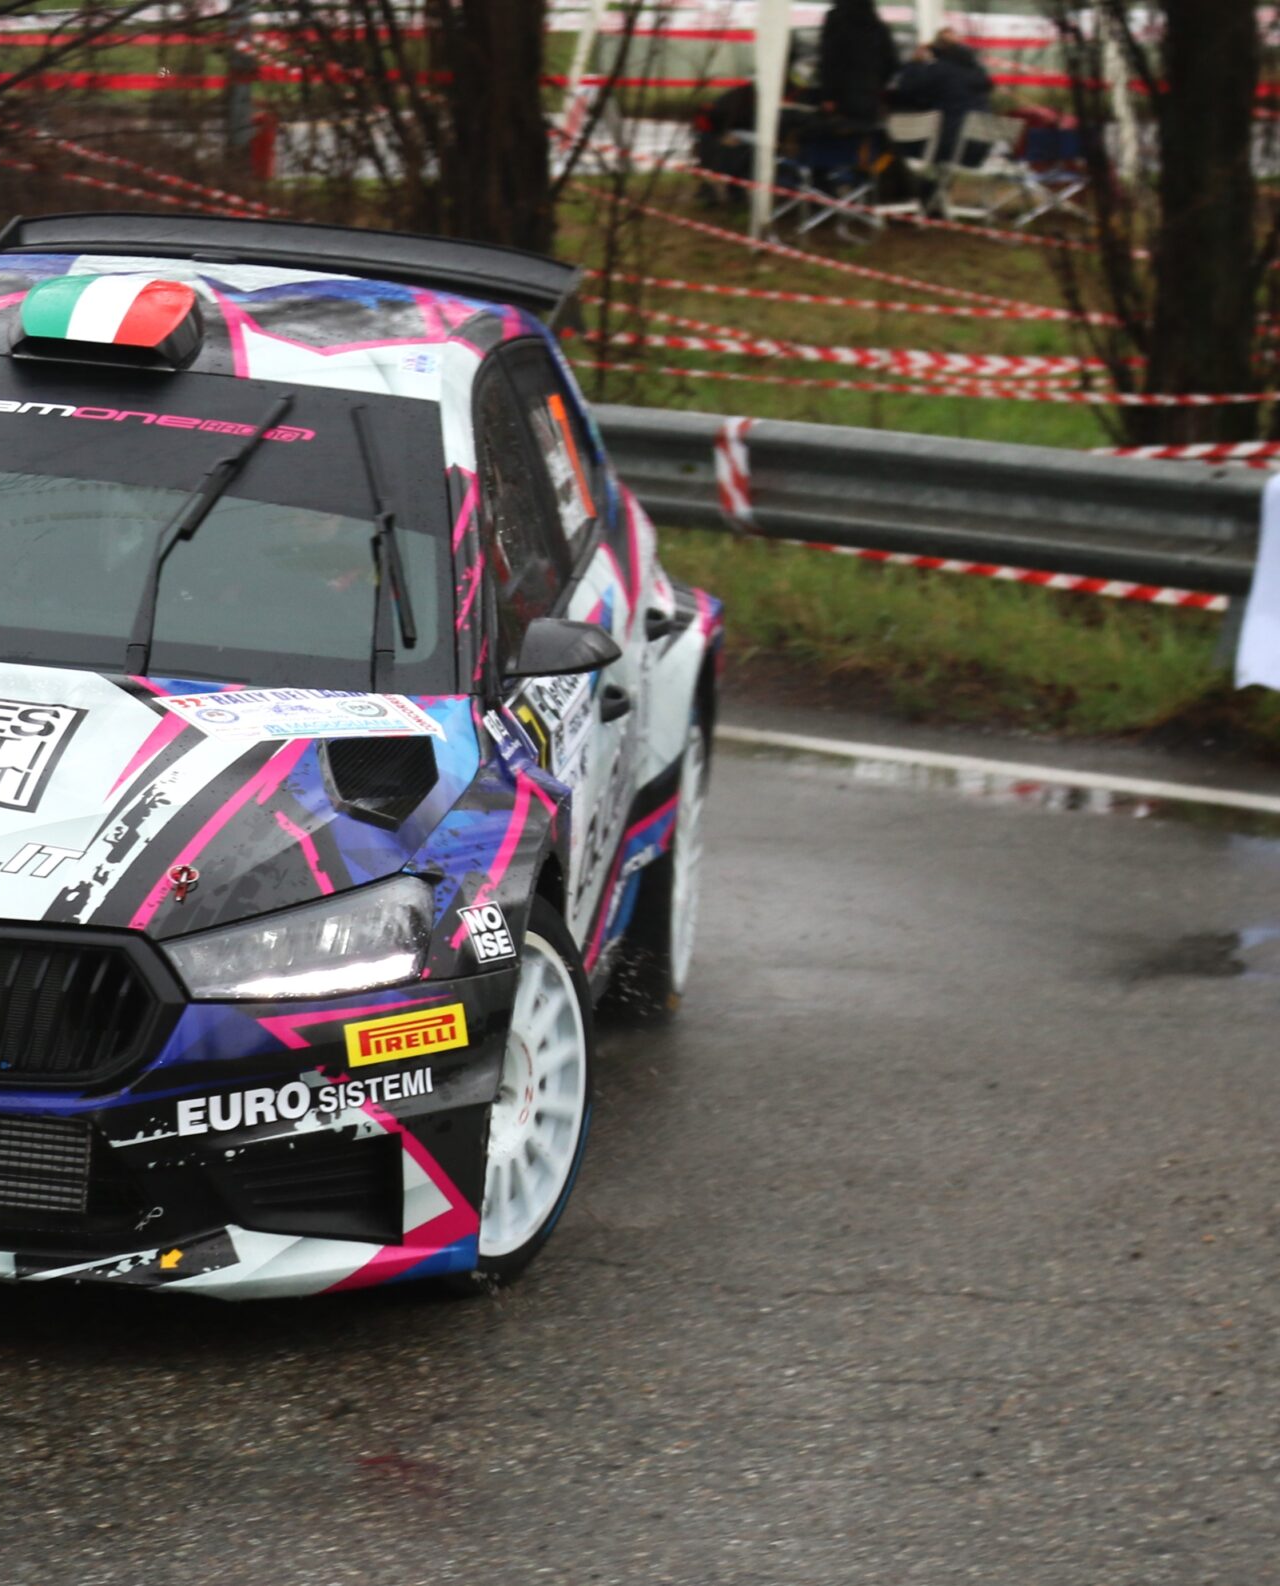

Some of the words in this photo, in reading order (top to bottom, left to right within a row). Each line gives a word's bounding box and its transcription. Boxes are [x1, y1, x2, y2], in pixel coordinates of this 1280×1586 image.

[209, 692, 271, 706] RALLY
[270, 687, 310, 701] DEI
[463, 906, 502, 934] NO
[473, 929, 513, 959] ISE
[358, 1013, 456, 1057] PIRELLI
[177, 1081, 311, 1137] EURO
[319, 1067, 433, 1113] SISTEMI
